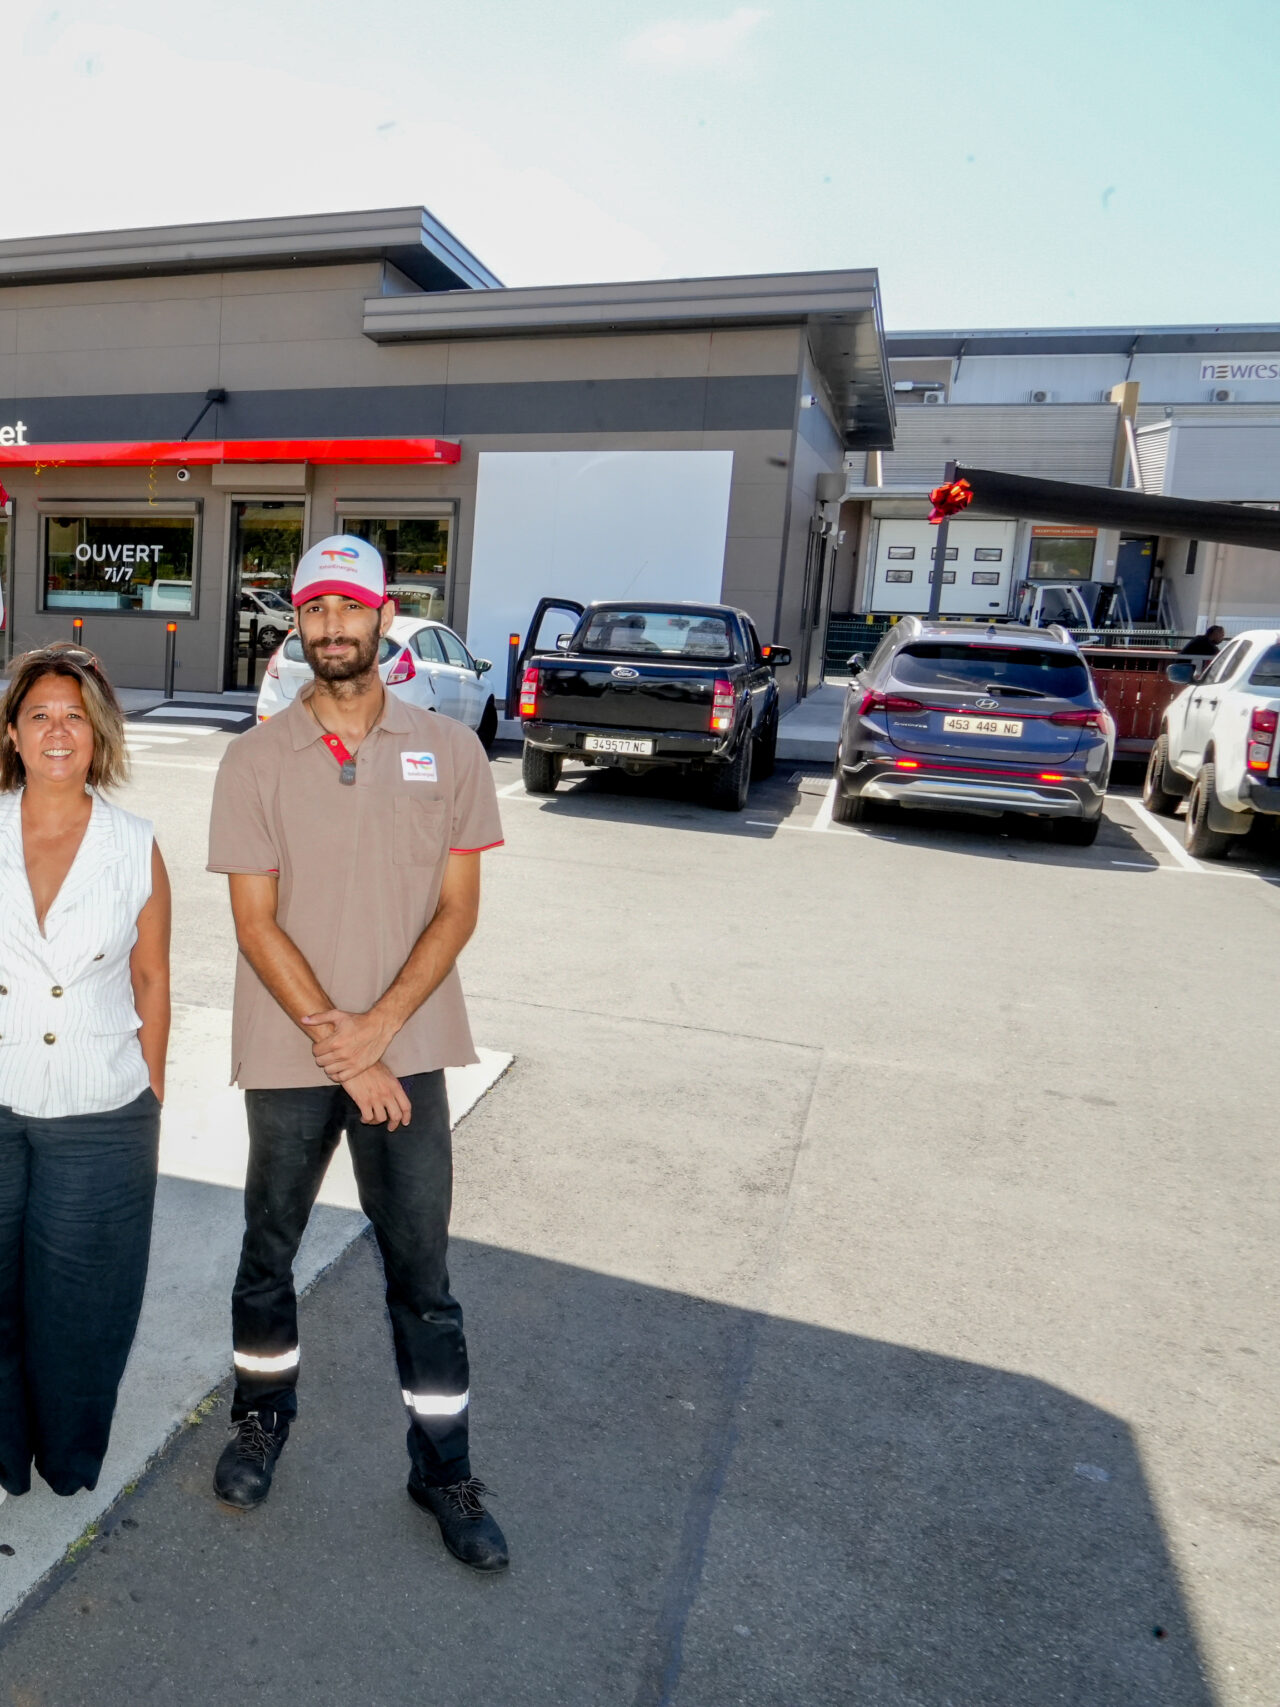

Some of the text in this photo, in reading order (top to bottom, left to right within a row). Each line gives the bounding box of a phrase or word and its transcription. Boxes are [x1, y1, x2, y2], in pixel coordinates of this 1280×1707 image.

[1202, 364, 1280, 379] newres
[75, 543, 164, 563] OUVERT
[104, 566, 134, 583] 7j/7
[948, 719, 1019, 734] 453 449 NC
[592, 739, 646, 753] 349577 NC
